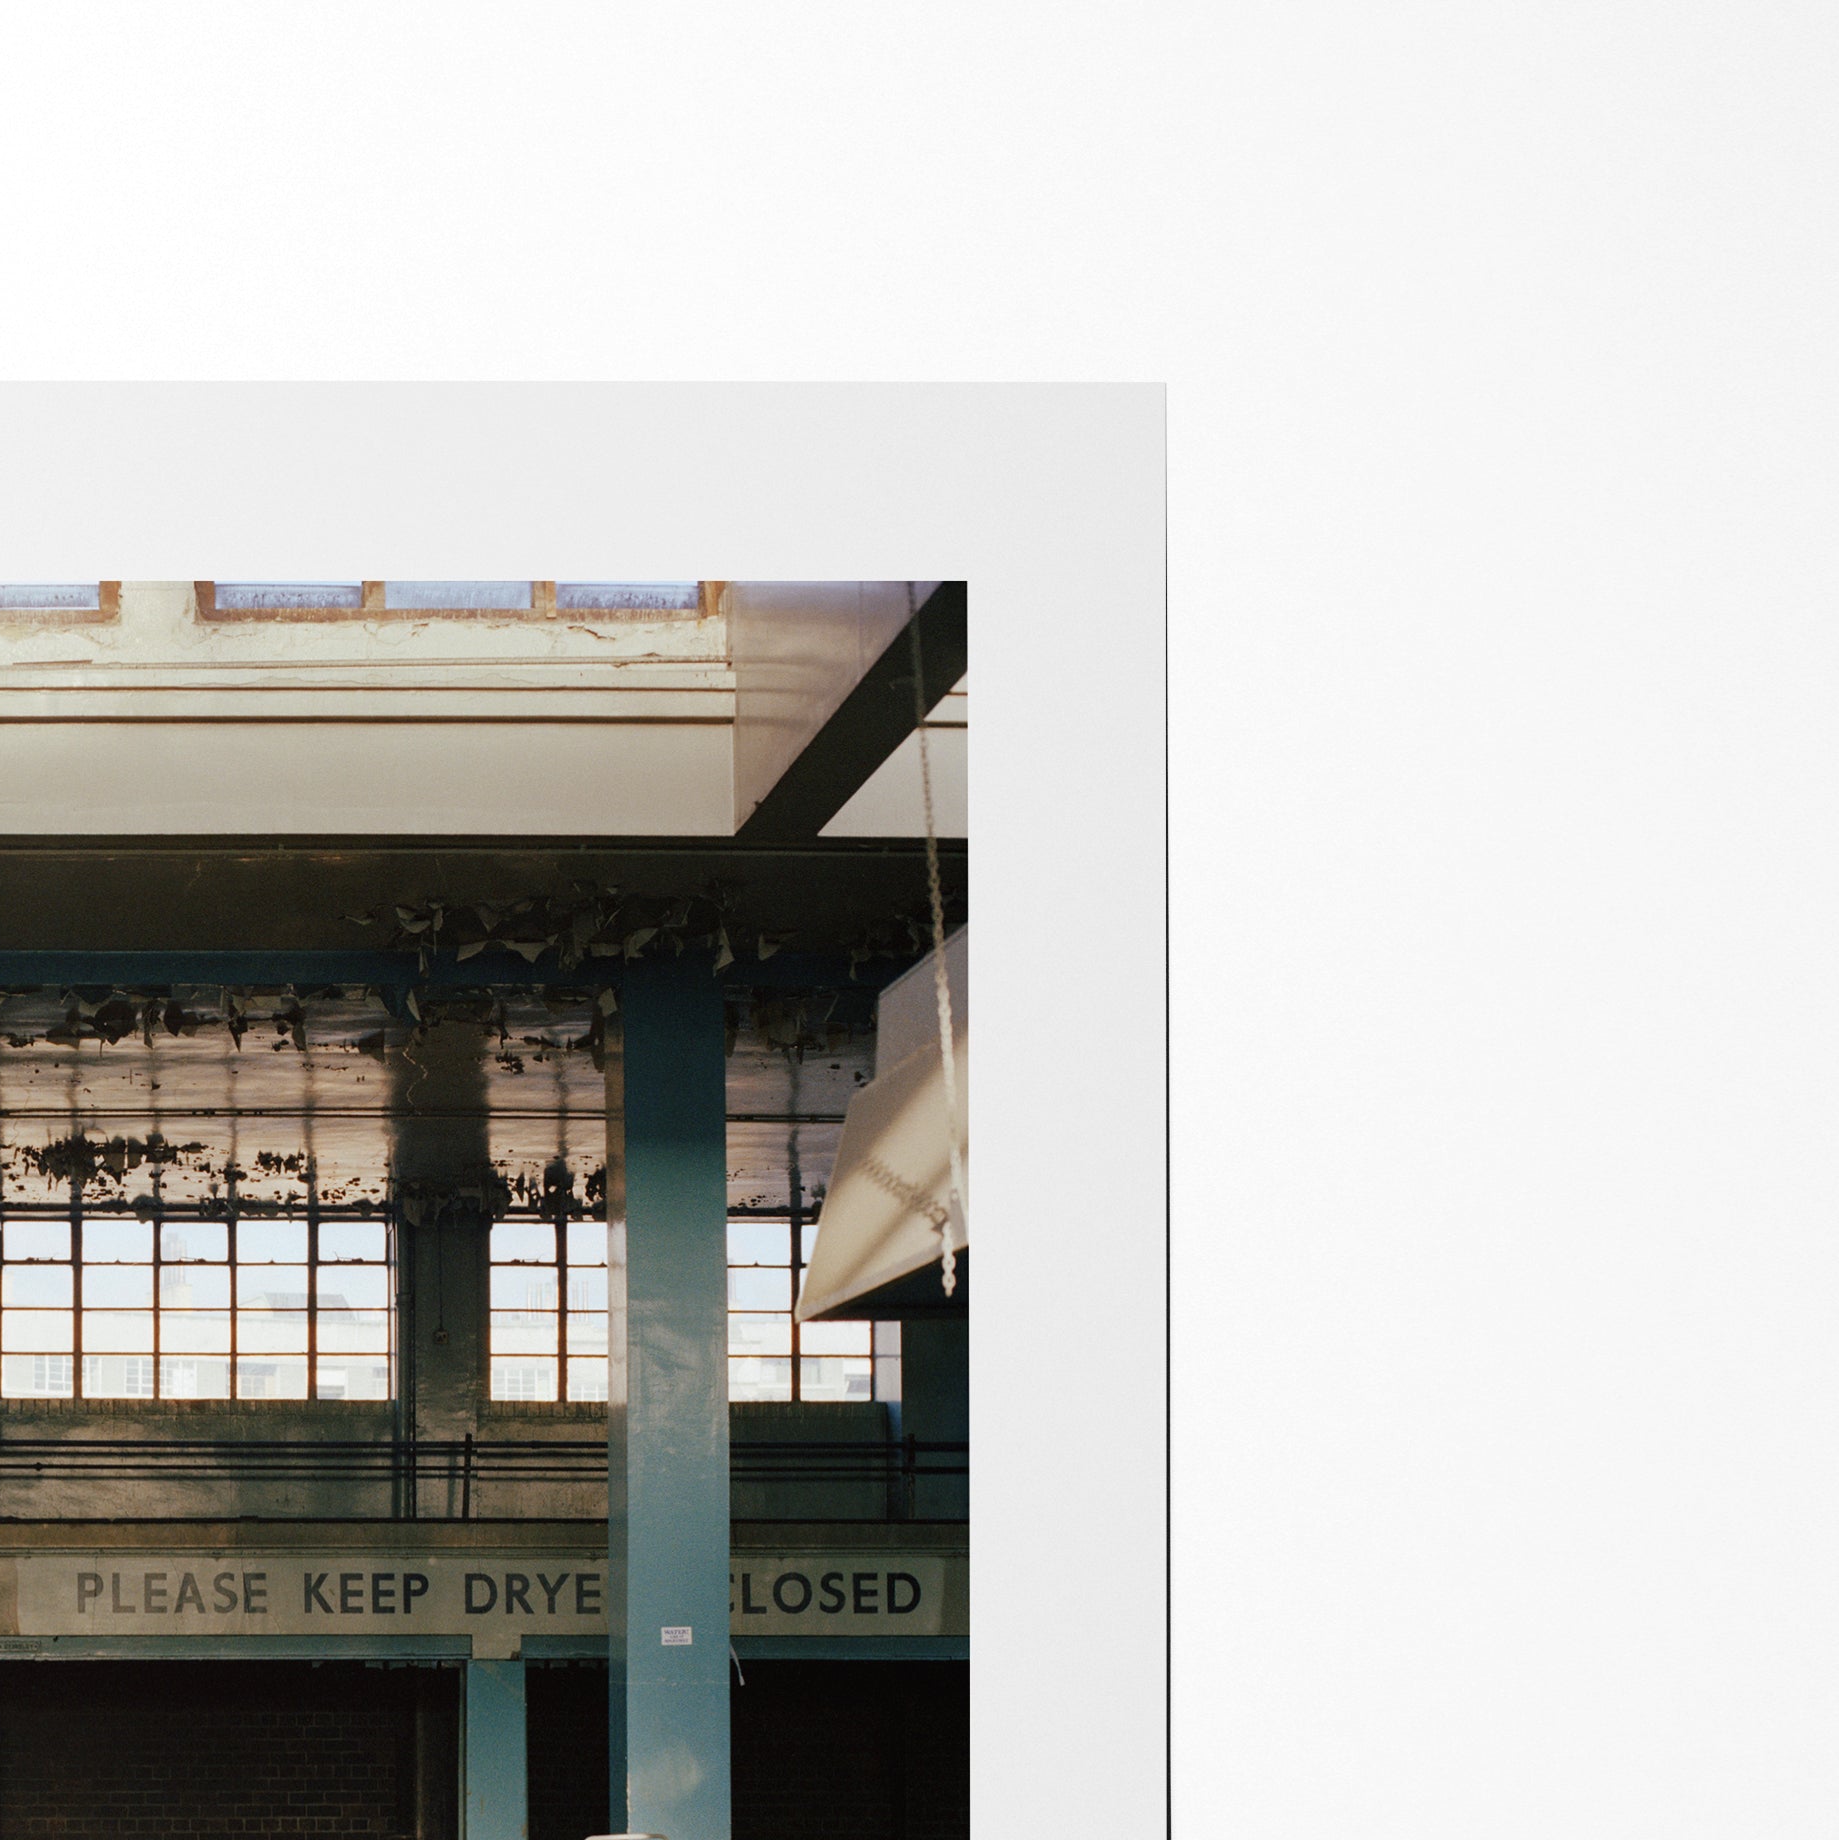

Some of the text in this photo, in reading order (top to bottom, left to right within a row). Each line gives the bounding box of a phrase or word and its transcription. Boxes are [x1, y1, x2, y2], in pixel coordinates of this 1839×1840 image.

[77, 1572, 922, 1614] PLEASE KEEP DRYE LOSED
